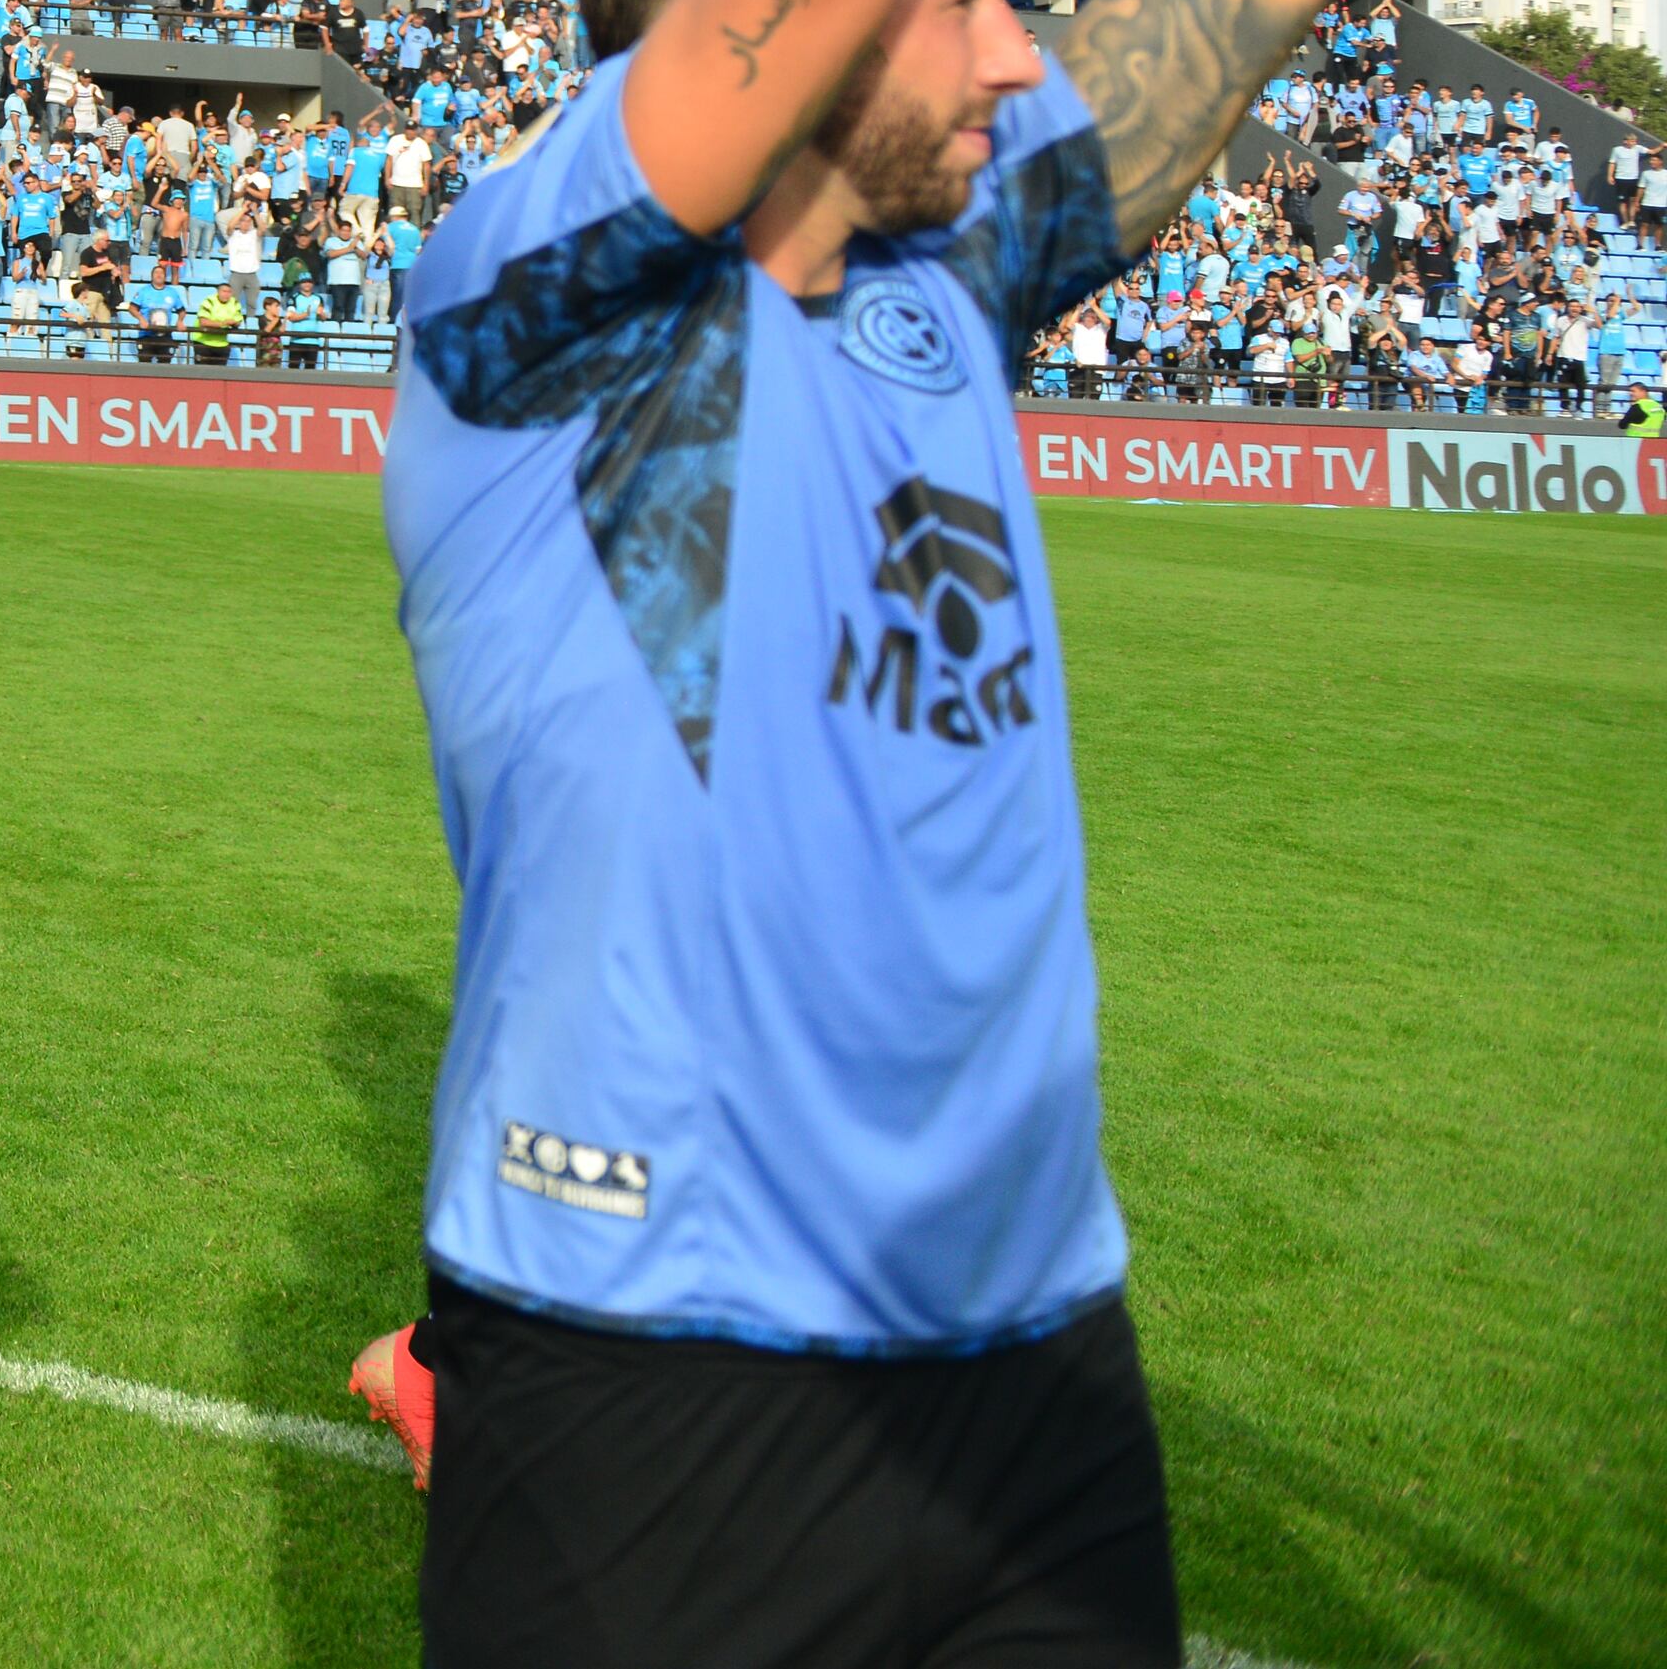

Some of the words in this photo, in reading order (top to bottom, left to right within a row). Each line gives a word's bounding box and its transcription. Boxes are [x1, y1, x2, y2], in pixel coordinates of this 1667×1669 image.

[99, 398, 314, 453] SMART
[1038, 434, 1108, 482] EN
[1124, 438, 1302, 489] SMART
[1313, 446, 1377, 491] TV
[1407, 441, 1626, 514] Naldo
